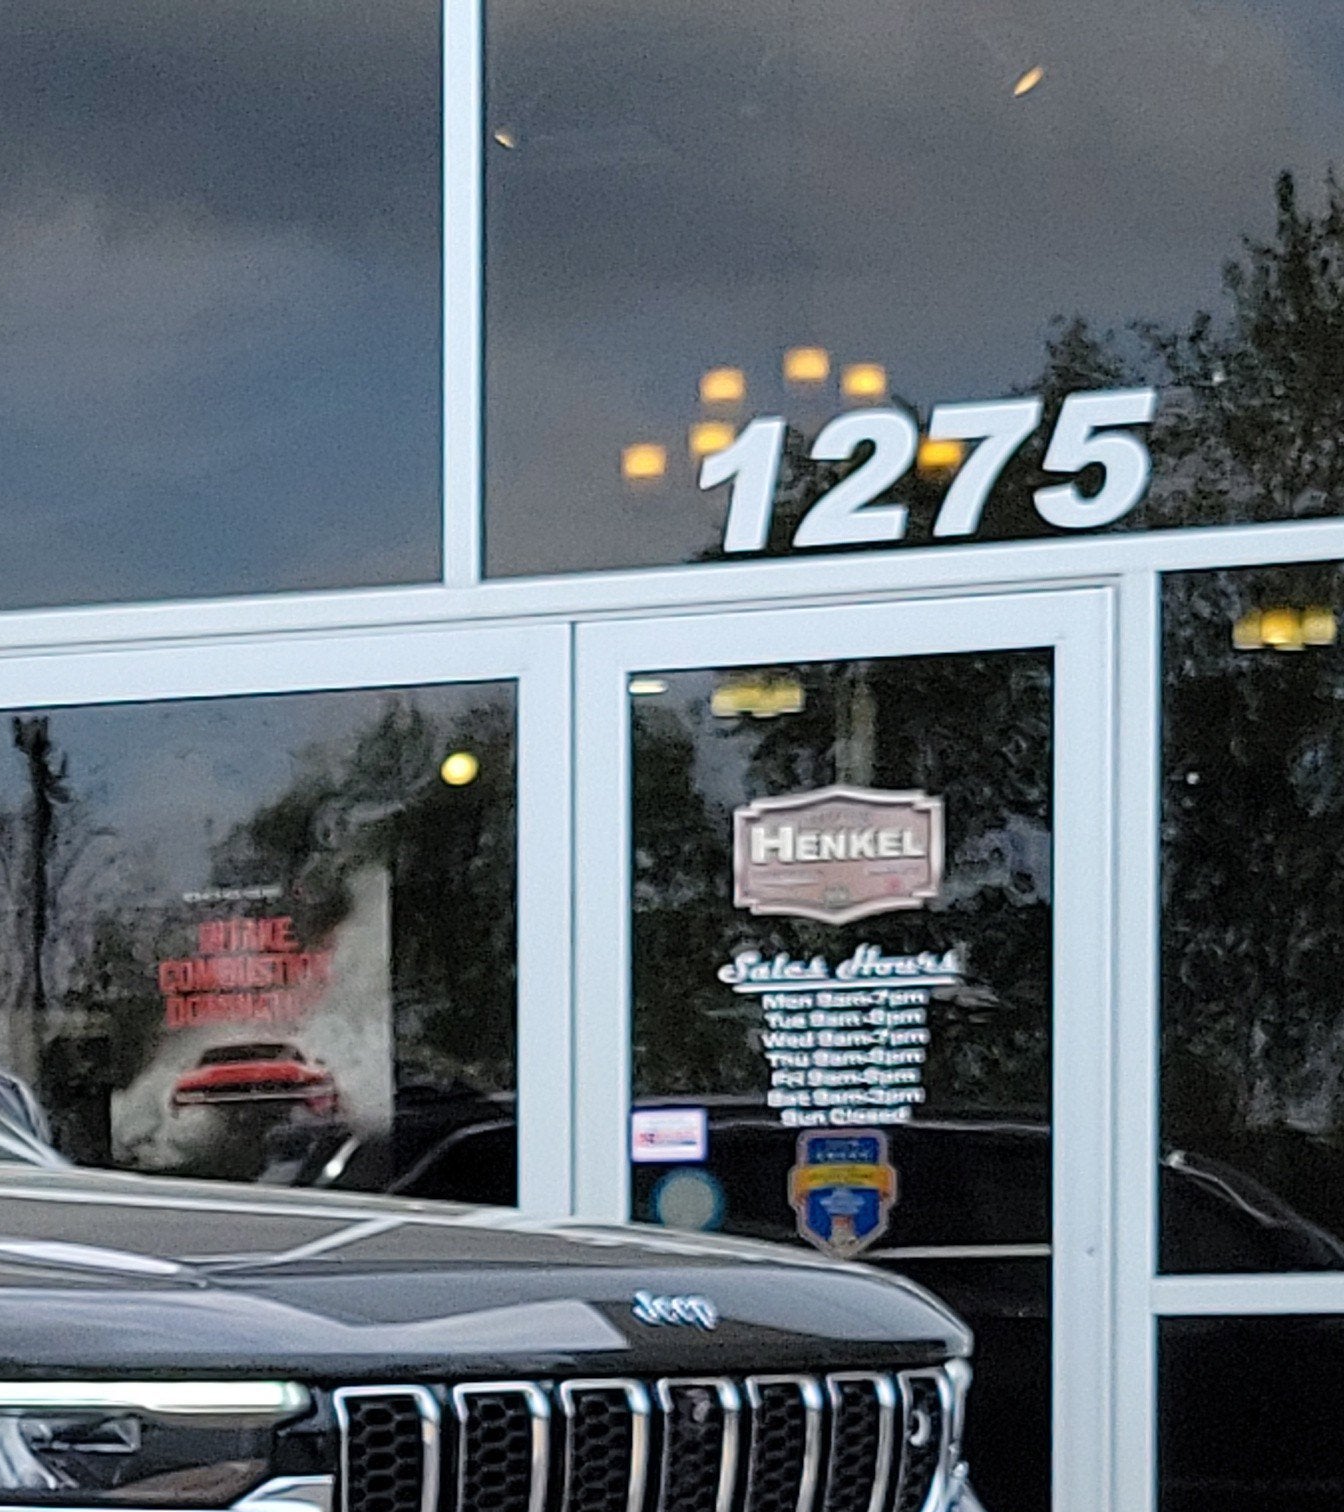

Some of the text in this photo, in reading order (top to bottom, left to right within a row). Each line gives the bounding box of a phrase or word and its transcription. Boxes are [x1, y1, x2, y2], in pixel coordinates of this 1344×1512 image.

[698, 387, 1158, 554] 1275
[751, 826, 928, 864] HENKEL
[717, 942, 962, 984] Sales Hours
[829, 1106, 911, 1125] Closed
[632, 1289, 717, 1330] Jeep
